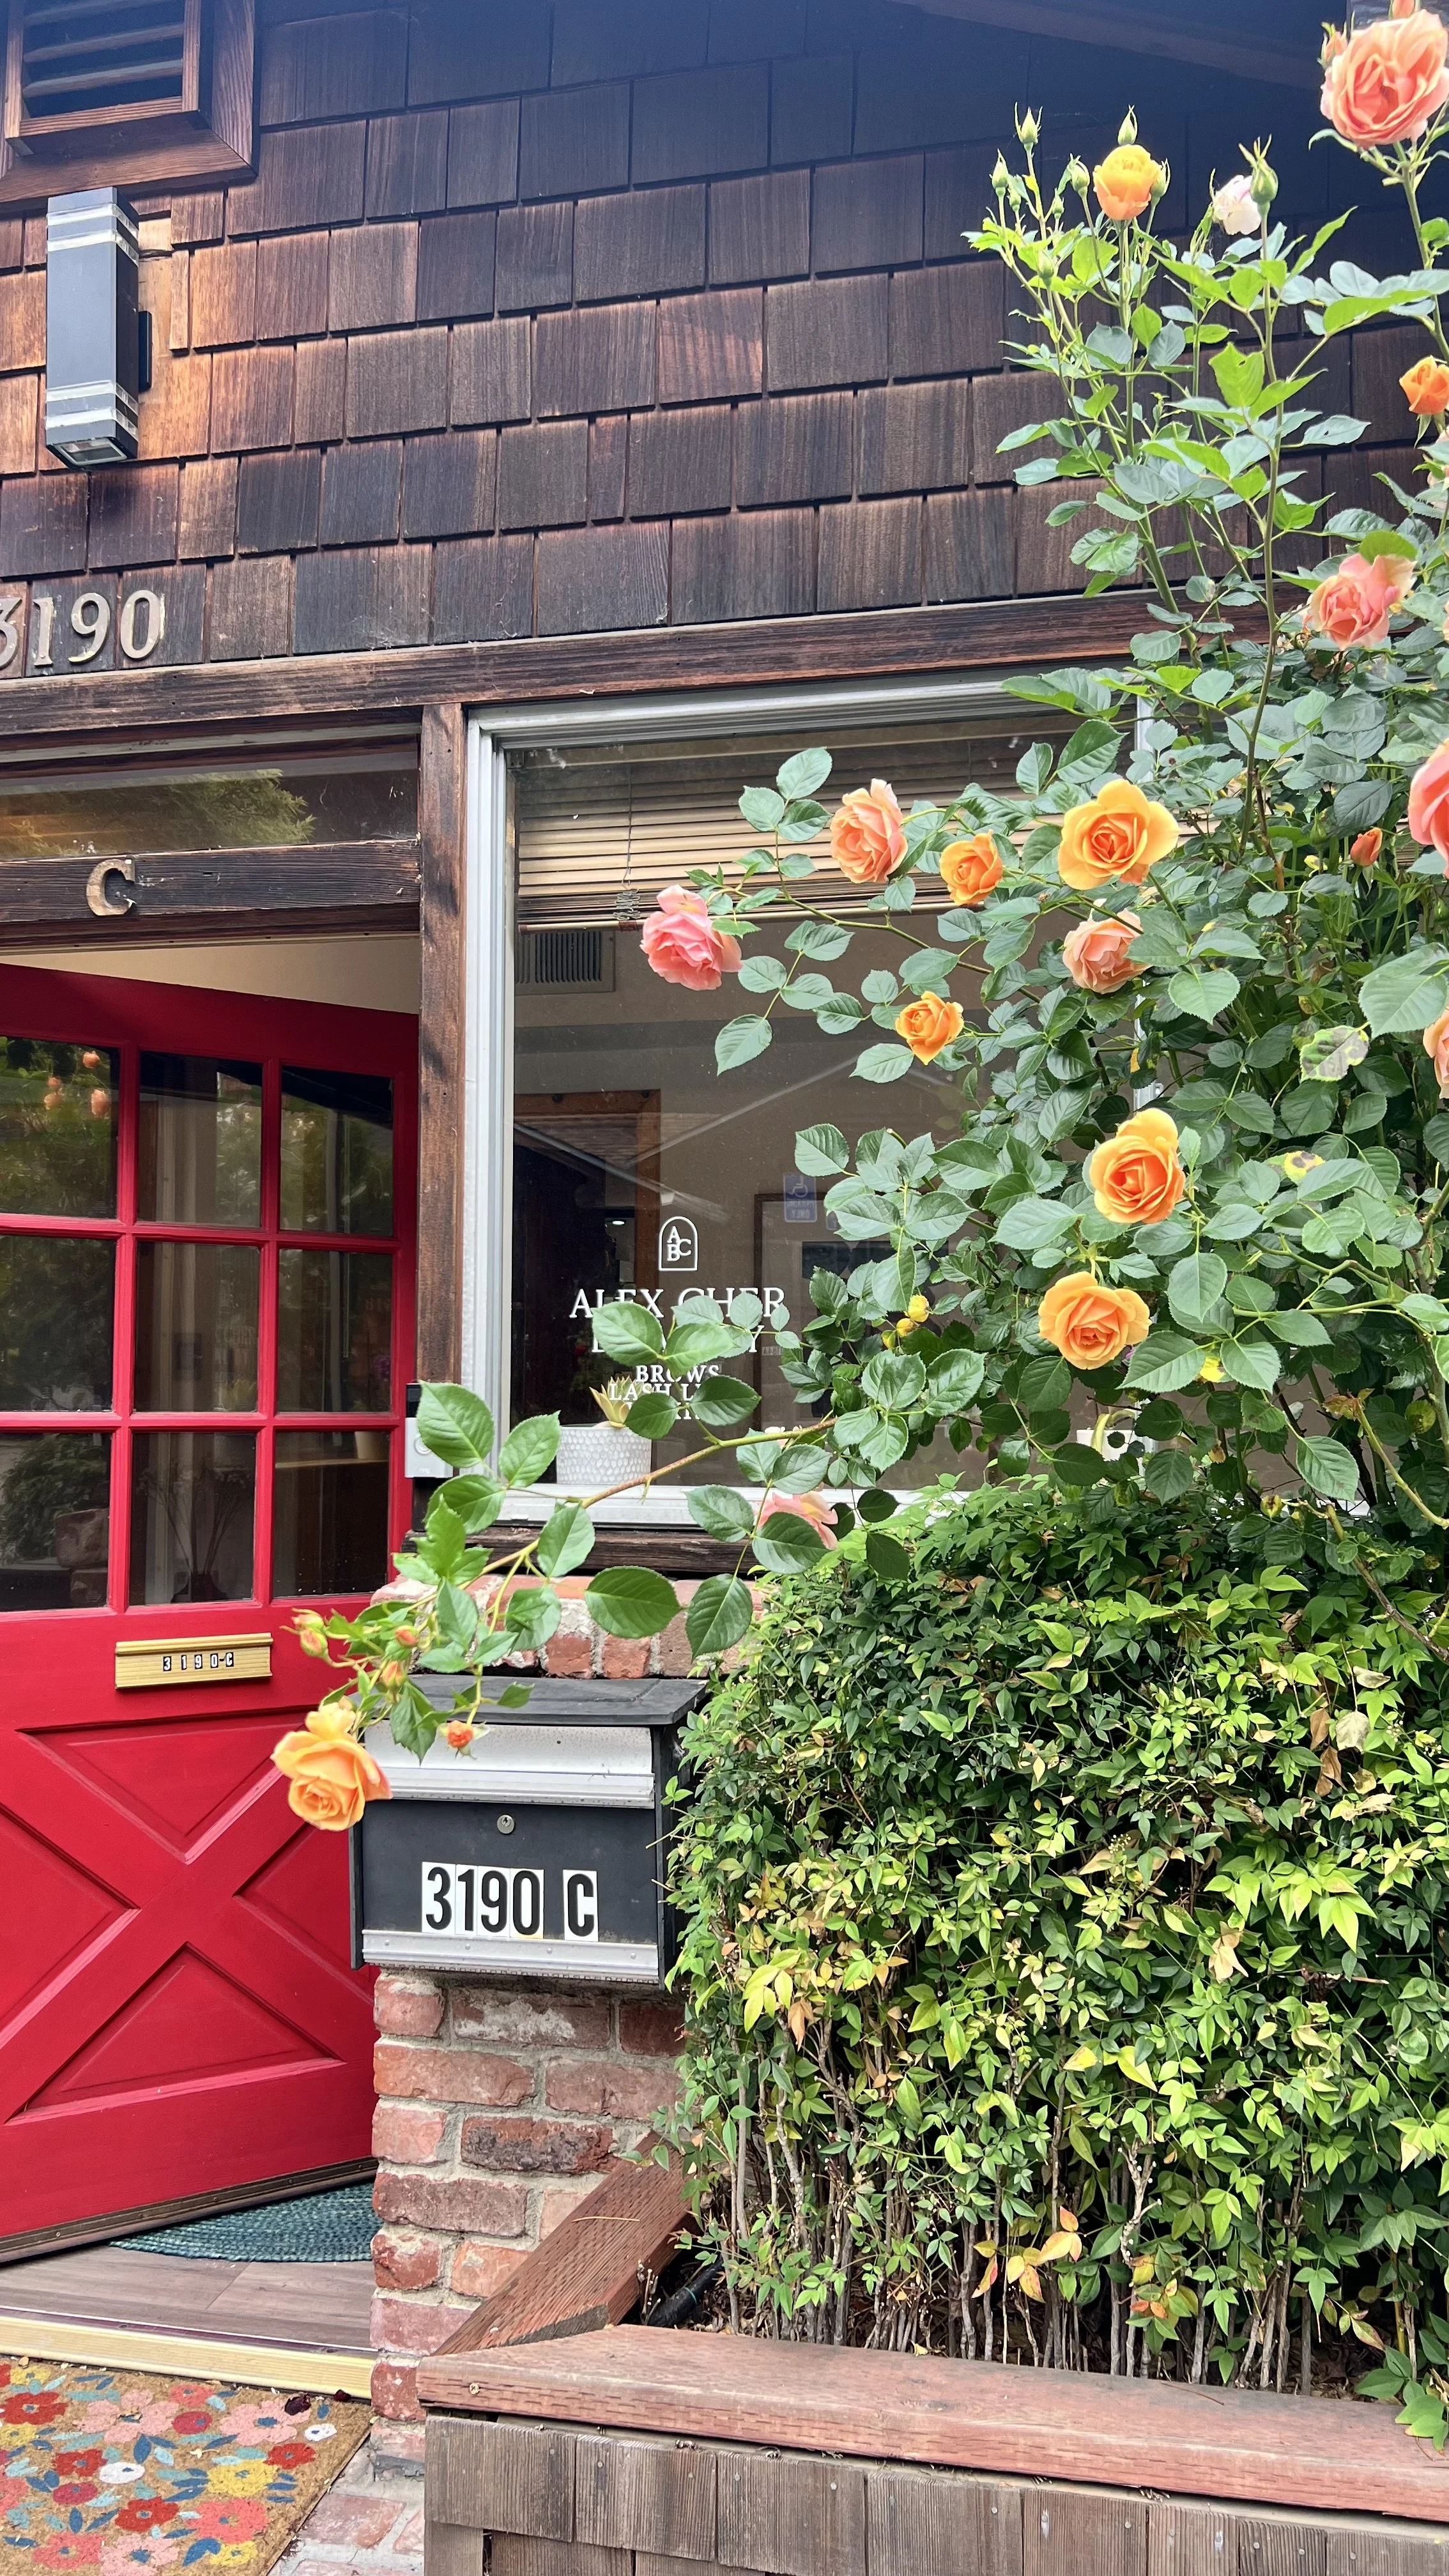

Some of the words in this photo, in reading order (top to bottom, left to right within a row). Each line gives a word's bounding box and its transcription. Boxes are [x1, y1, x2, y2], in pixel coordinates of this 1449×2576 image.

[0, 589, 161, 669] 3190
[86, 859, 136, 916] C
[677, 1287, 786, 1318] CHR
[425, 1866, 540, 1936] 3190
[567, 1873, 595, 1937] C
